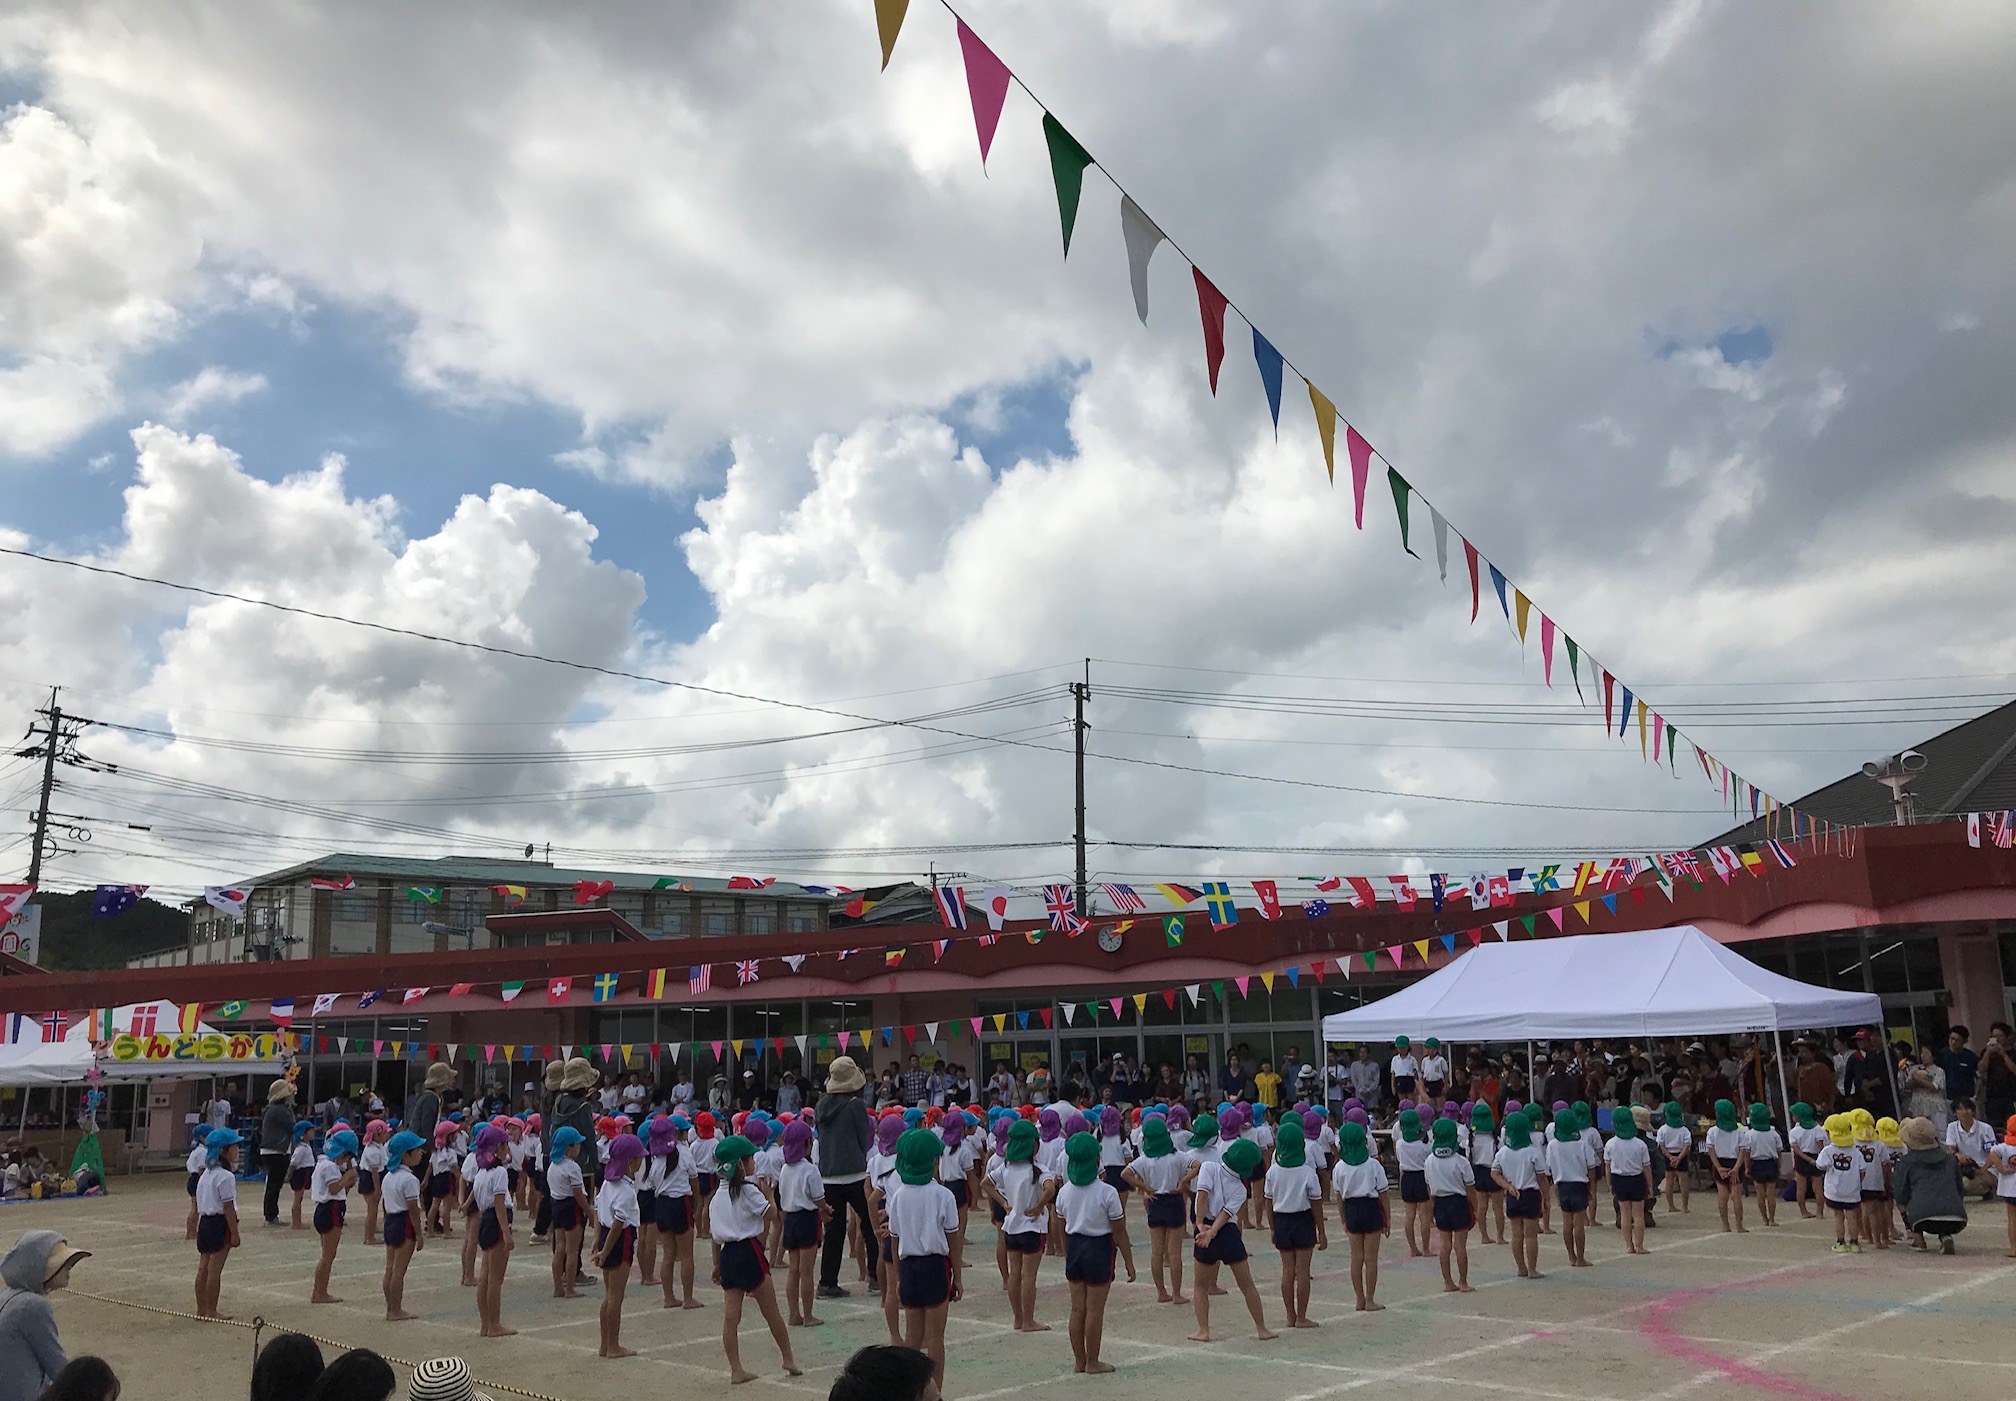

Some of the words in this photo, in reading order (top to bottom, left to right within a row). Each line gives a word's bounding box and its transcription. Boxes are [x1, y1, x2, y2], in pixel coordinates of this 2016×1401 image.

[117, 1035, 278, 1060] うんどうかい
